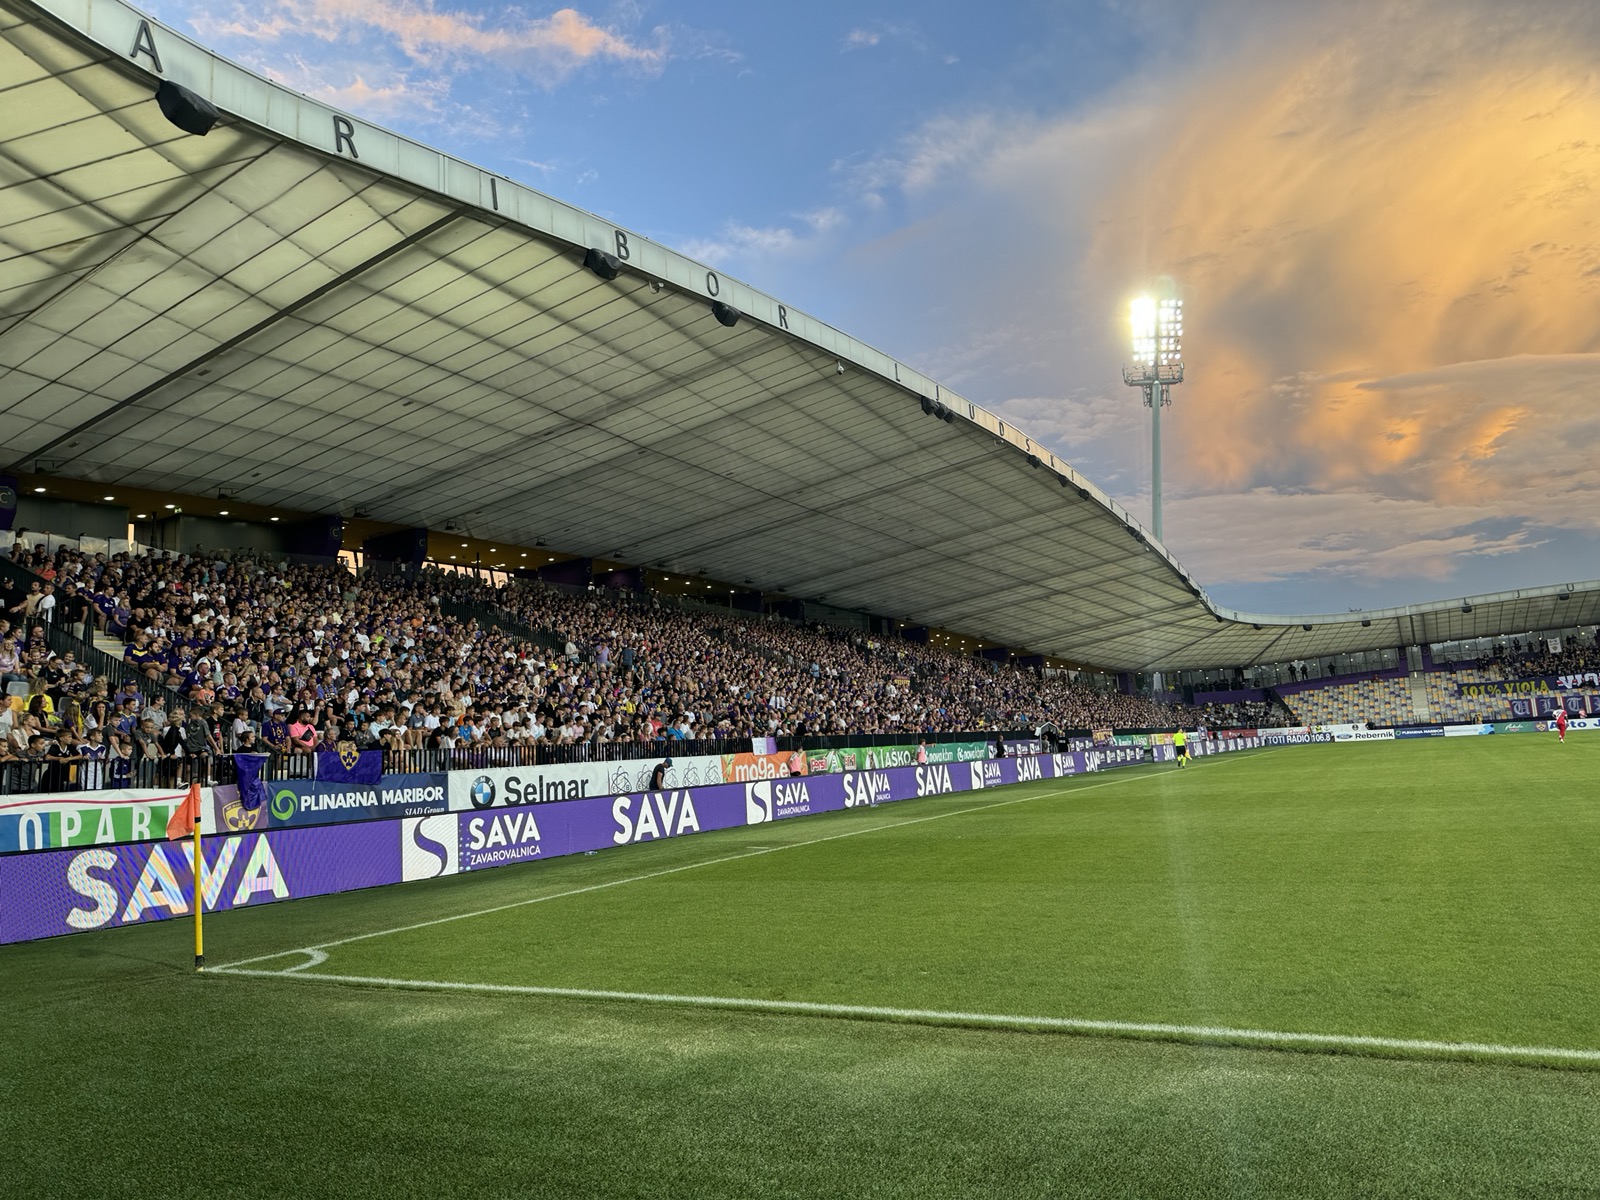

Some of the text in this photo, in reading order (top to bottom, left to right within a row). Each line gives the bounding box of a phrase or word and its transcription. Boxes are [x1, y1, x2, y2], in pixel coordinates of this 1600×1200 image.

[1504, 680, 1549, 694] VIOLA
[1355, 731, 1393, 740] Rebernik
[1549, 720, 1587, 730] Ato
[1268, 734, 1284, 745] TOTI
[1287, 733, 1310, 744] RADIO
[1312, 733, 1331, 742] 106.8
[735, 757, 790, 782] moga.e
[915, 764, 953, 796] SAVA
[984, 762, 1001, 778] SAVA
[1016, 756, 1042, 782] SAVA
[300, 786, 444, 812] PLINARNA MARIBOR
[504, 774, 589, 806] Selmar
[775, 782, 810, 806] SAVA
[612, 789, 700, 844] SAVA
[469, 811, 542, 851] SAVA
[470, 845, 541, 866] ZAVAROVALNICA
[65, 833, 290, 929] SAVA
